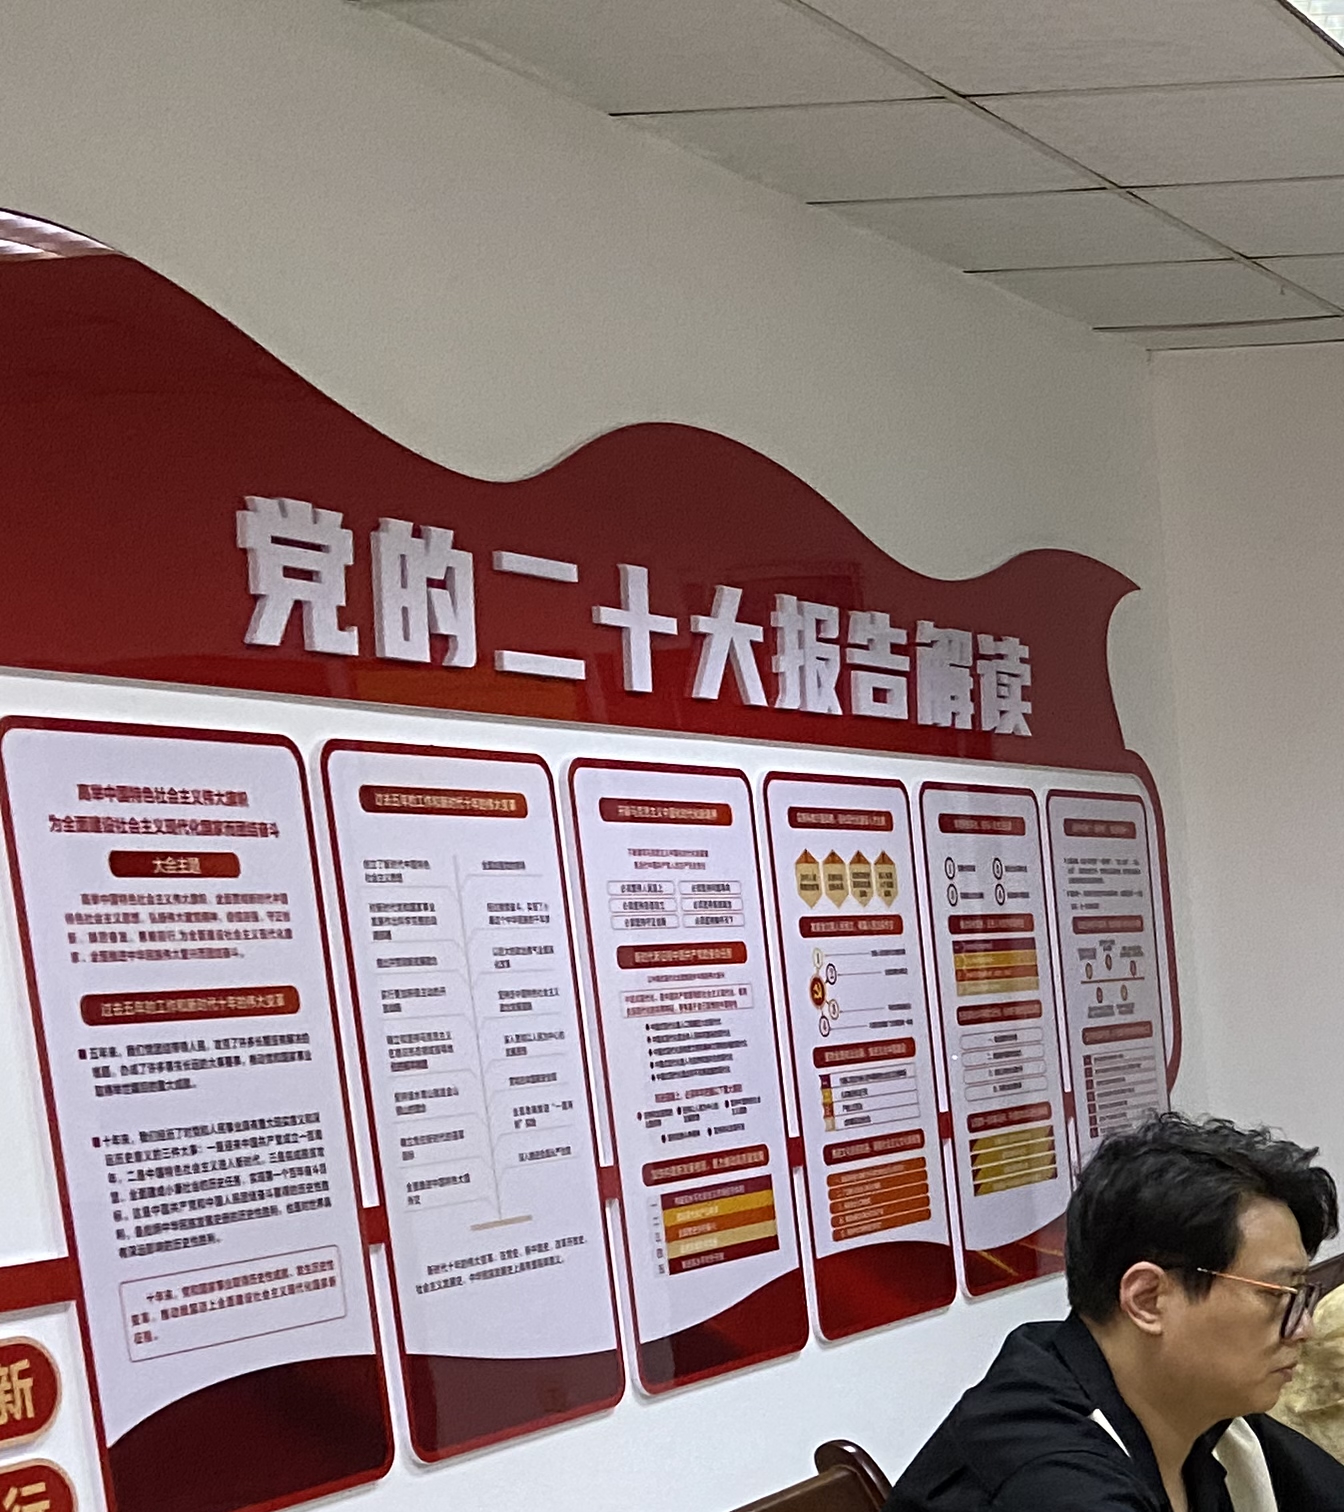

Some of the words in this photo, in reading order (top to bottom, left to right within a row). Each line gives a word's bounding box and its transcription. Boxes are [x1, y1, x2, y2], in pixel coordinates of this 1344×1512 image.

[236, 496, 1032, 737] 党的二十大报告解读
[152, 857, 202, 875] 大会主题
[0, 1359, 34, 1426] 新
